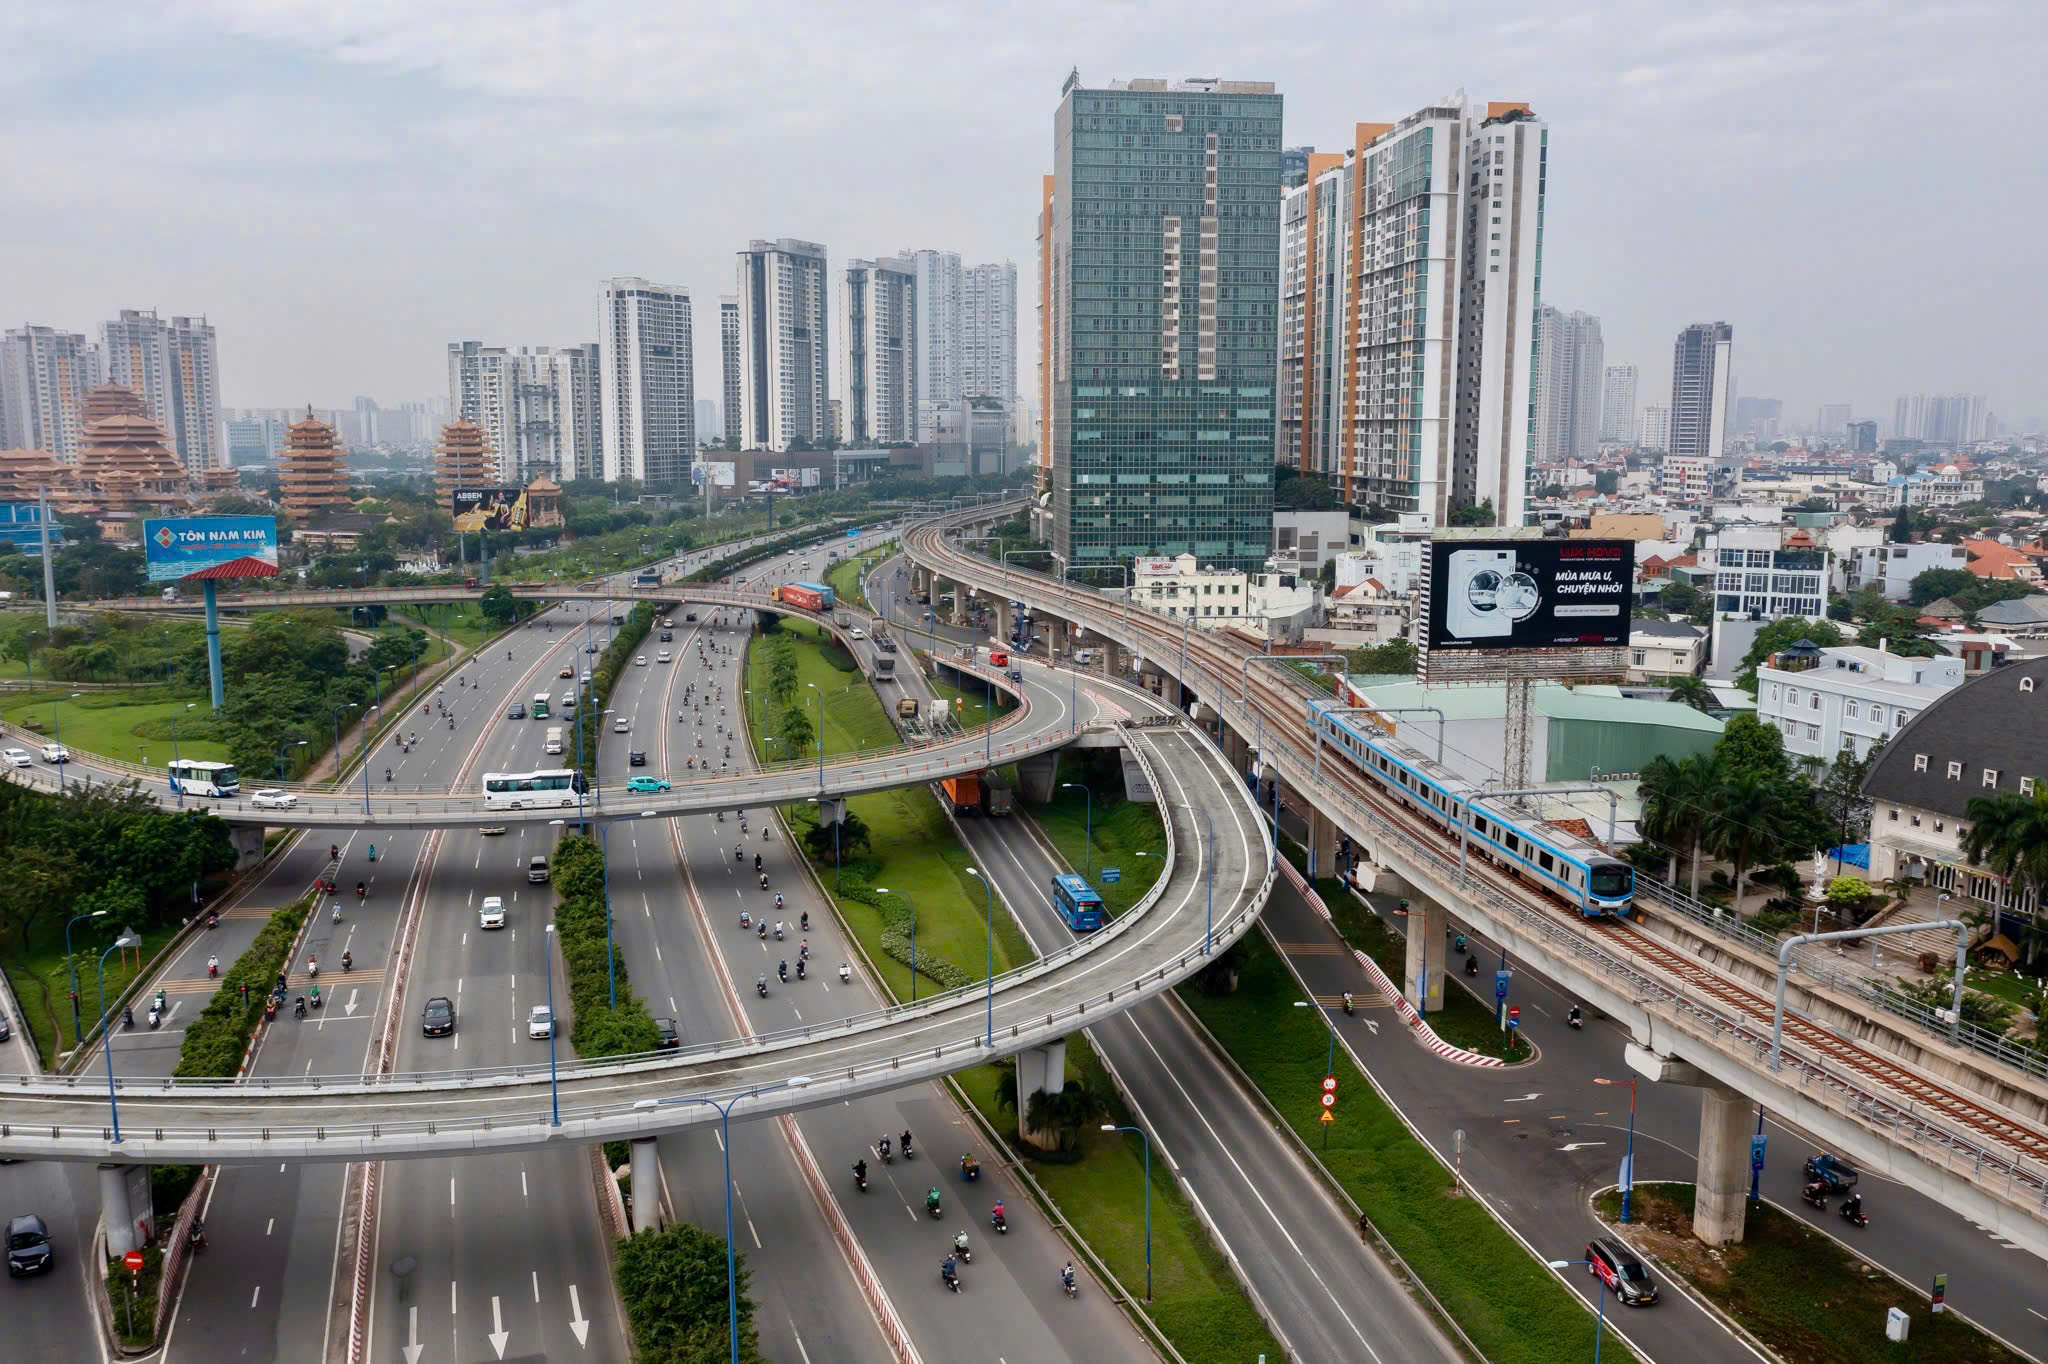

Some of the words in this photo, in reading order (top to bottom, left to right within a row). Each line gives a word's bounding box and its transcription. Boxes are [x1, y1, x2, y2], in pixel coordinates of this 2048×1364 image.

[178, 530, 205, 541] TÔN
[209, 530, 239, 541] NAM
[243, 530, 266, 540] KIM
[1560, 547, 1584, 557] LUX
[1555, 570, 1577, 581] MÙA
[1579, 570, 1601, 581] MƯA
[1603, 570, 1612, 583] Ư,
[1557, 583, 1596, 595] CHUYỆN
[1598, 582, 1622, 592] NHỎ!
